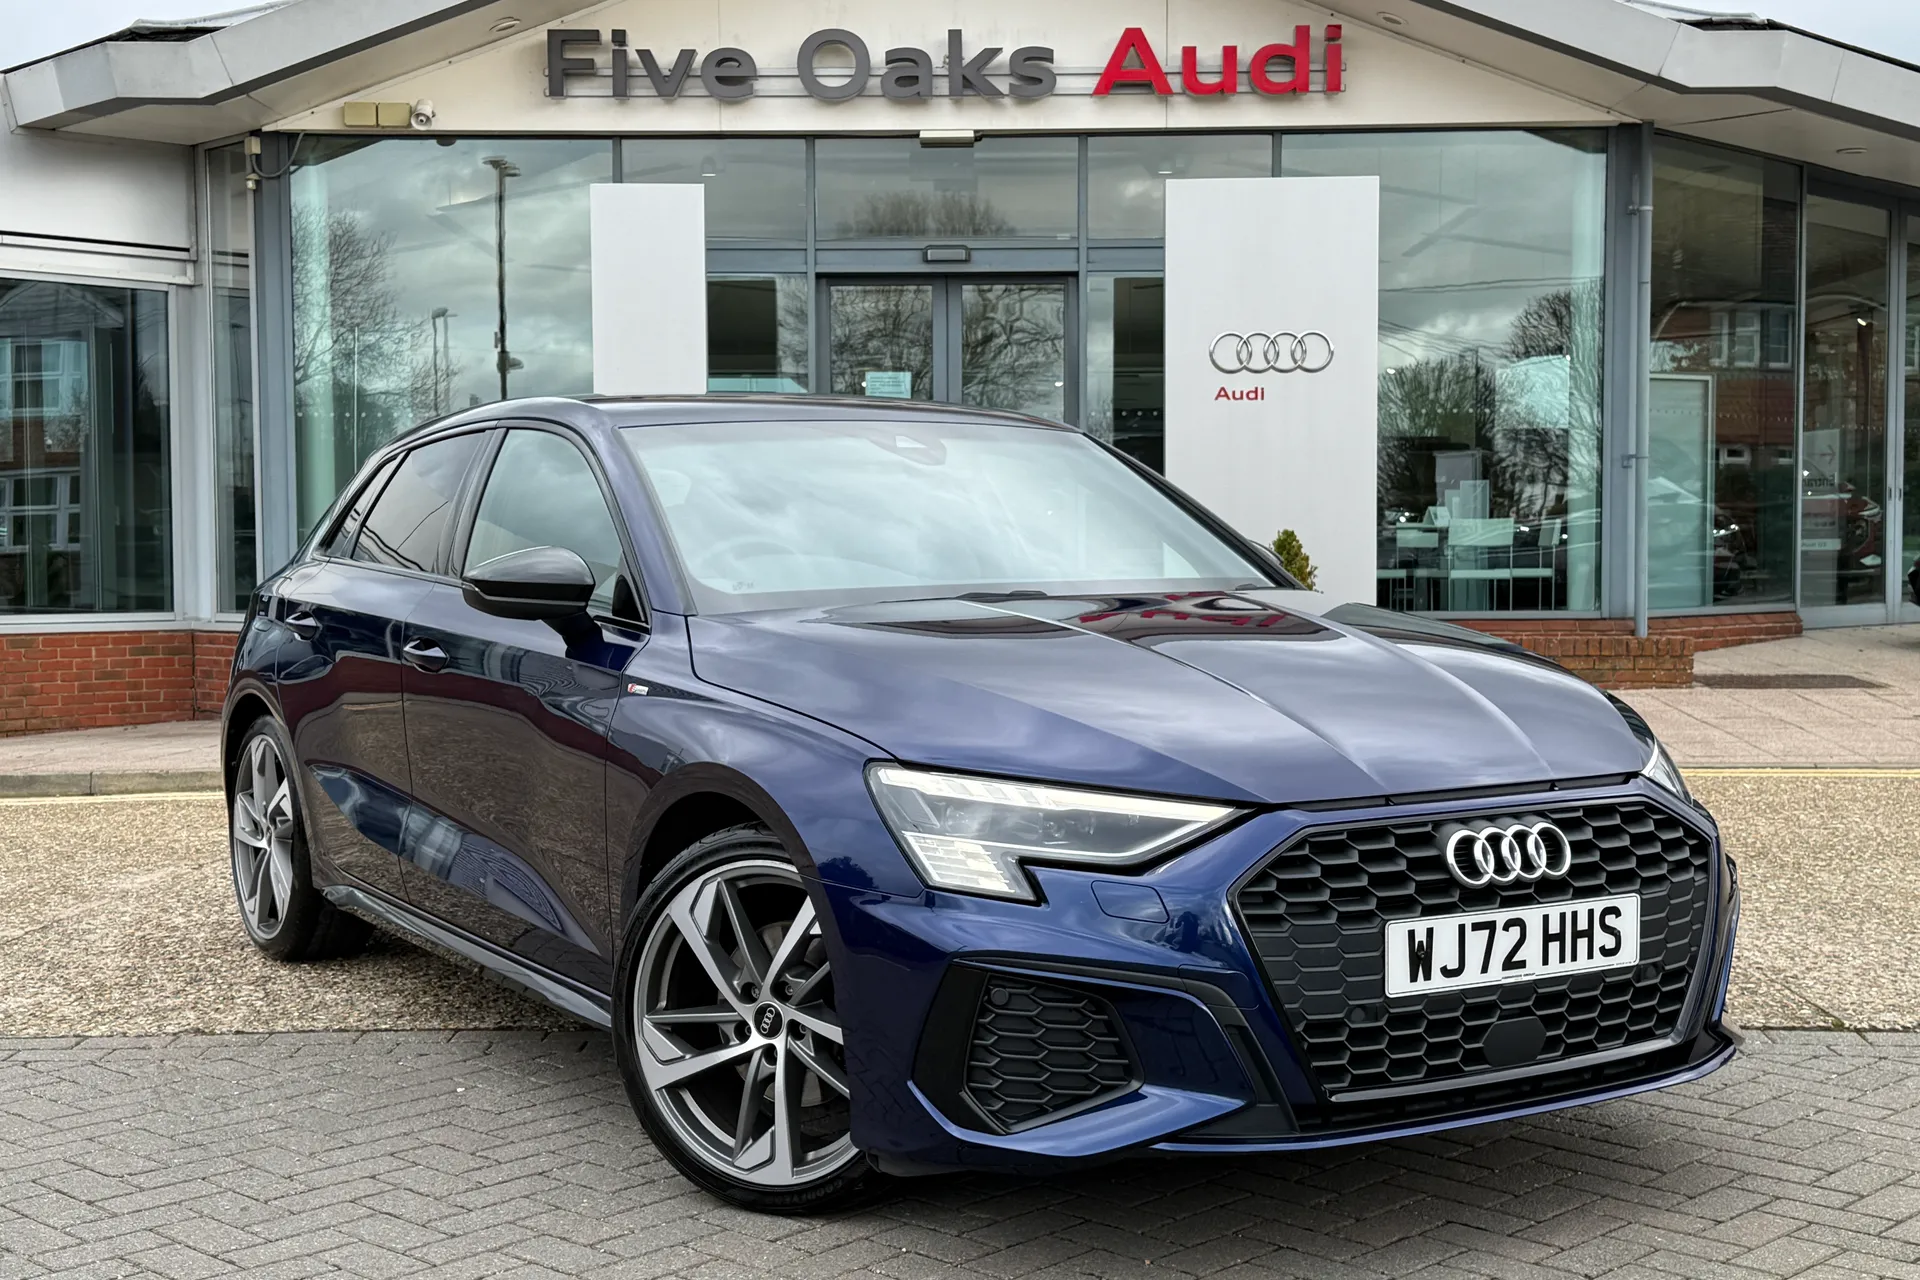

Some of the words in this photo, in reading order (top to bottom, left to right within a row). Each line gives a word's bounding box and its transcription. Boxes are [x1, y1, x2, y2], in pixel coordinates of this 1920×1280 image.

[547, 28, 758, 99] Five
[797, 28, 1057, 100] Oaks
[1092, 24, 1342, 97] Audi
[1214, 386, 1265, 401] Audi
[1407, 917, 1527, 984] WJ72
[1542, 905, 1622, 967] HHS
